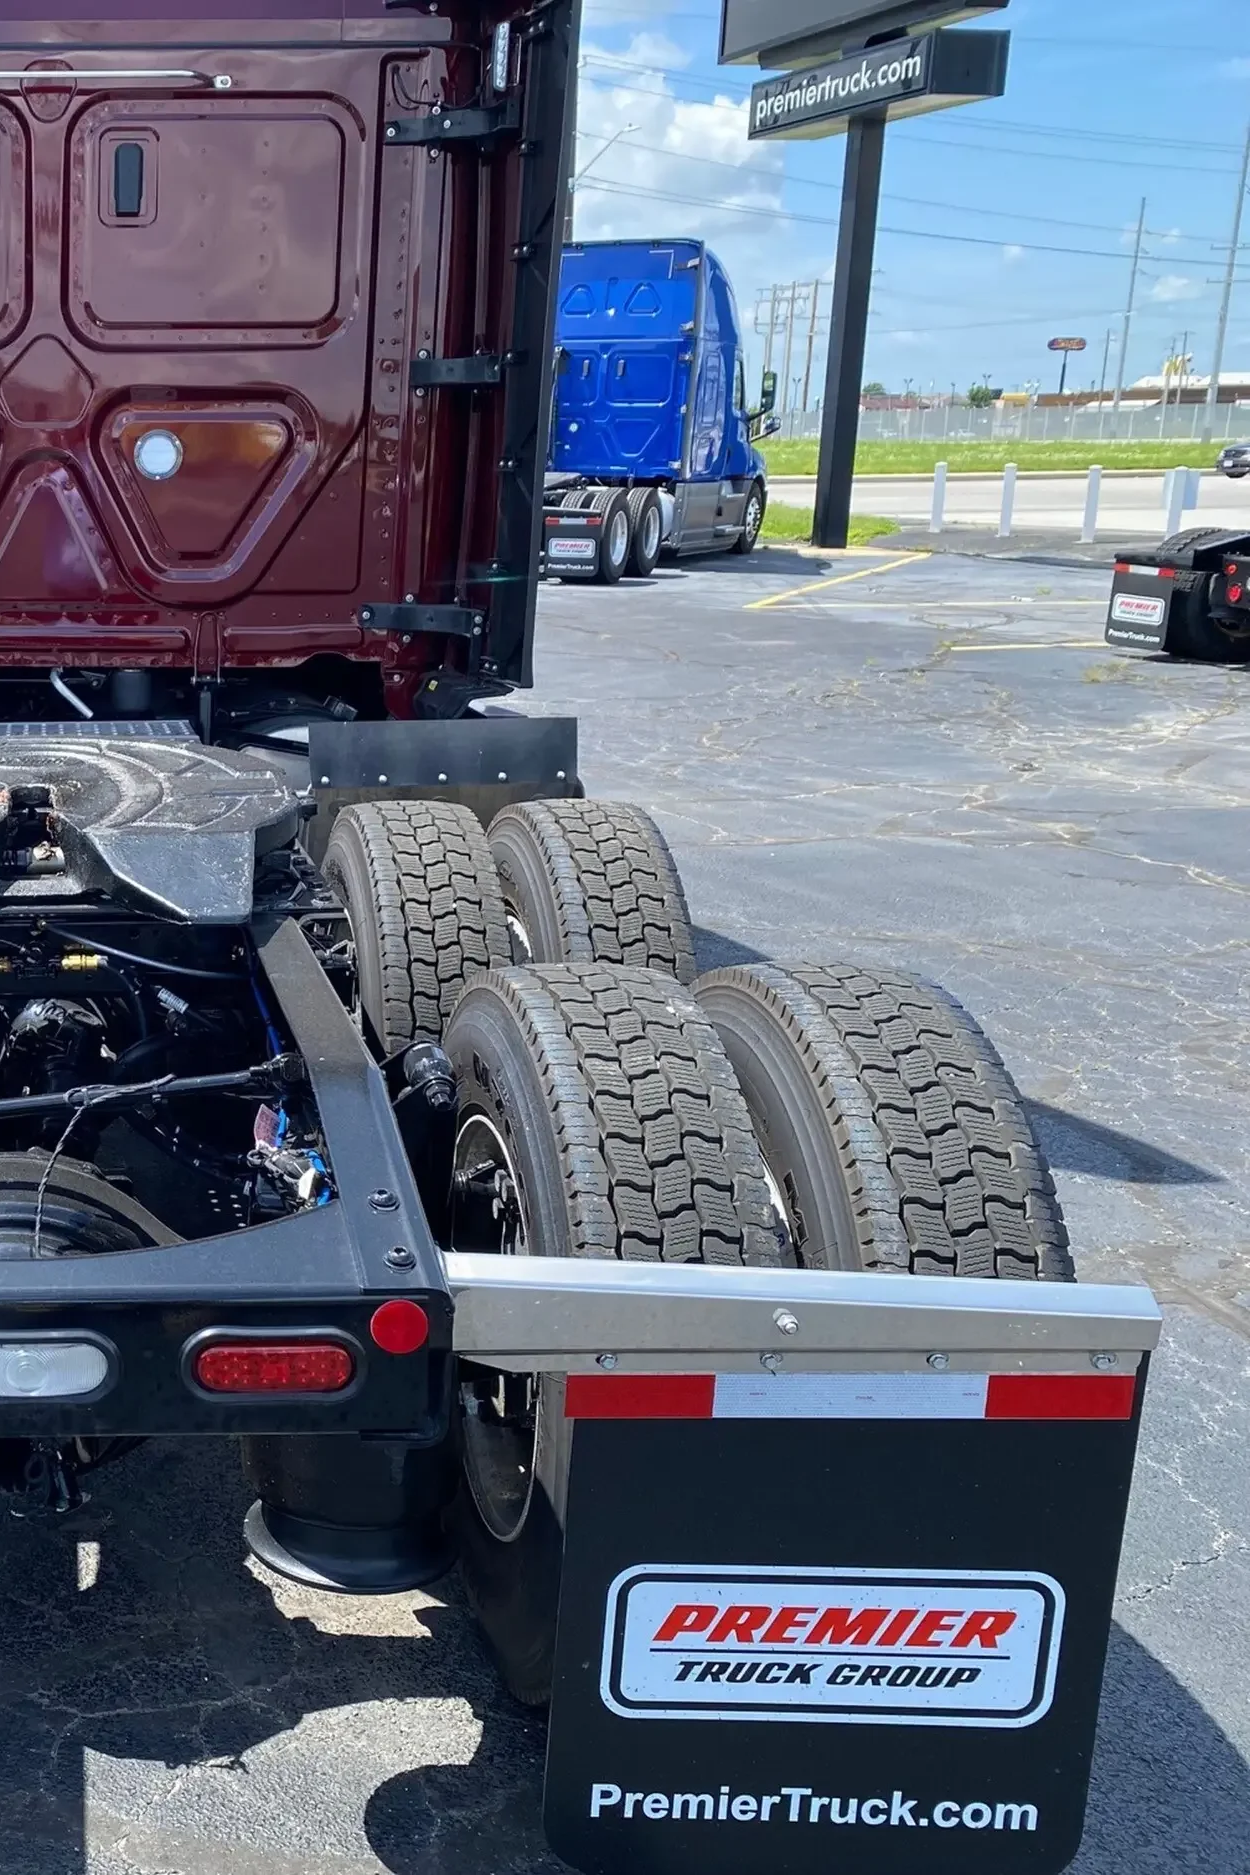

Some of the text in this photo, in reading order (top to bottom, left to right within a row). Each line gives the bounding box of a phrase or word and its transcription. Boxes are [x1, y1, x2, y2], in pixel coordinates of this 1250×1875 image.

[756, 54, 921, 125] premiertruck.com
[652, 1604, 1018, 1649] PREMIER
[673, 1660, 982, 1688] TRUCK GROUP
[589, 1783, 1038, 1831] PremierTruck.com
